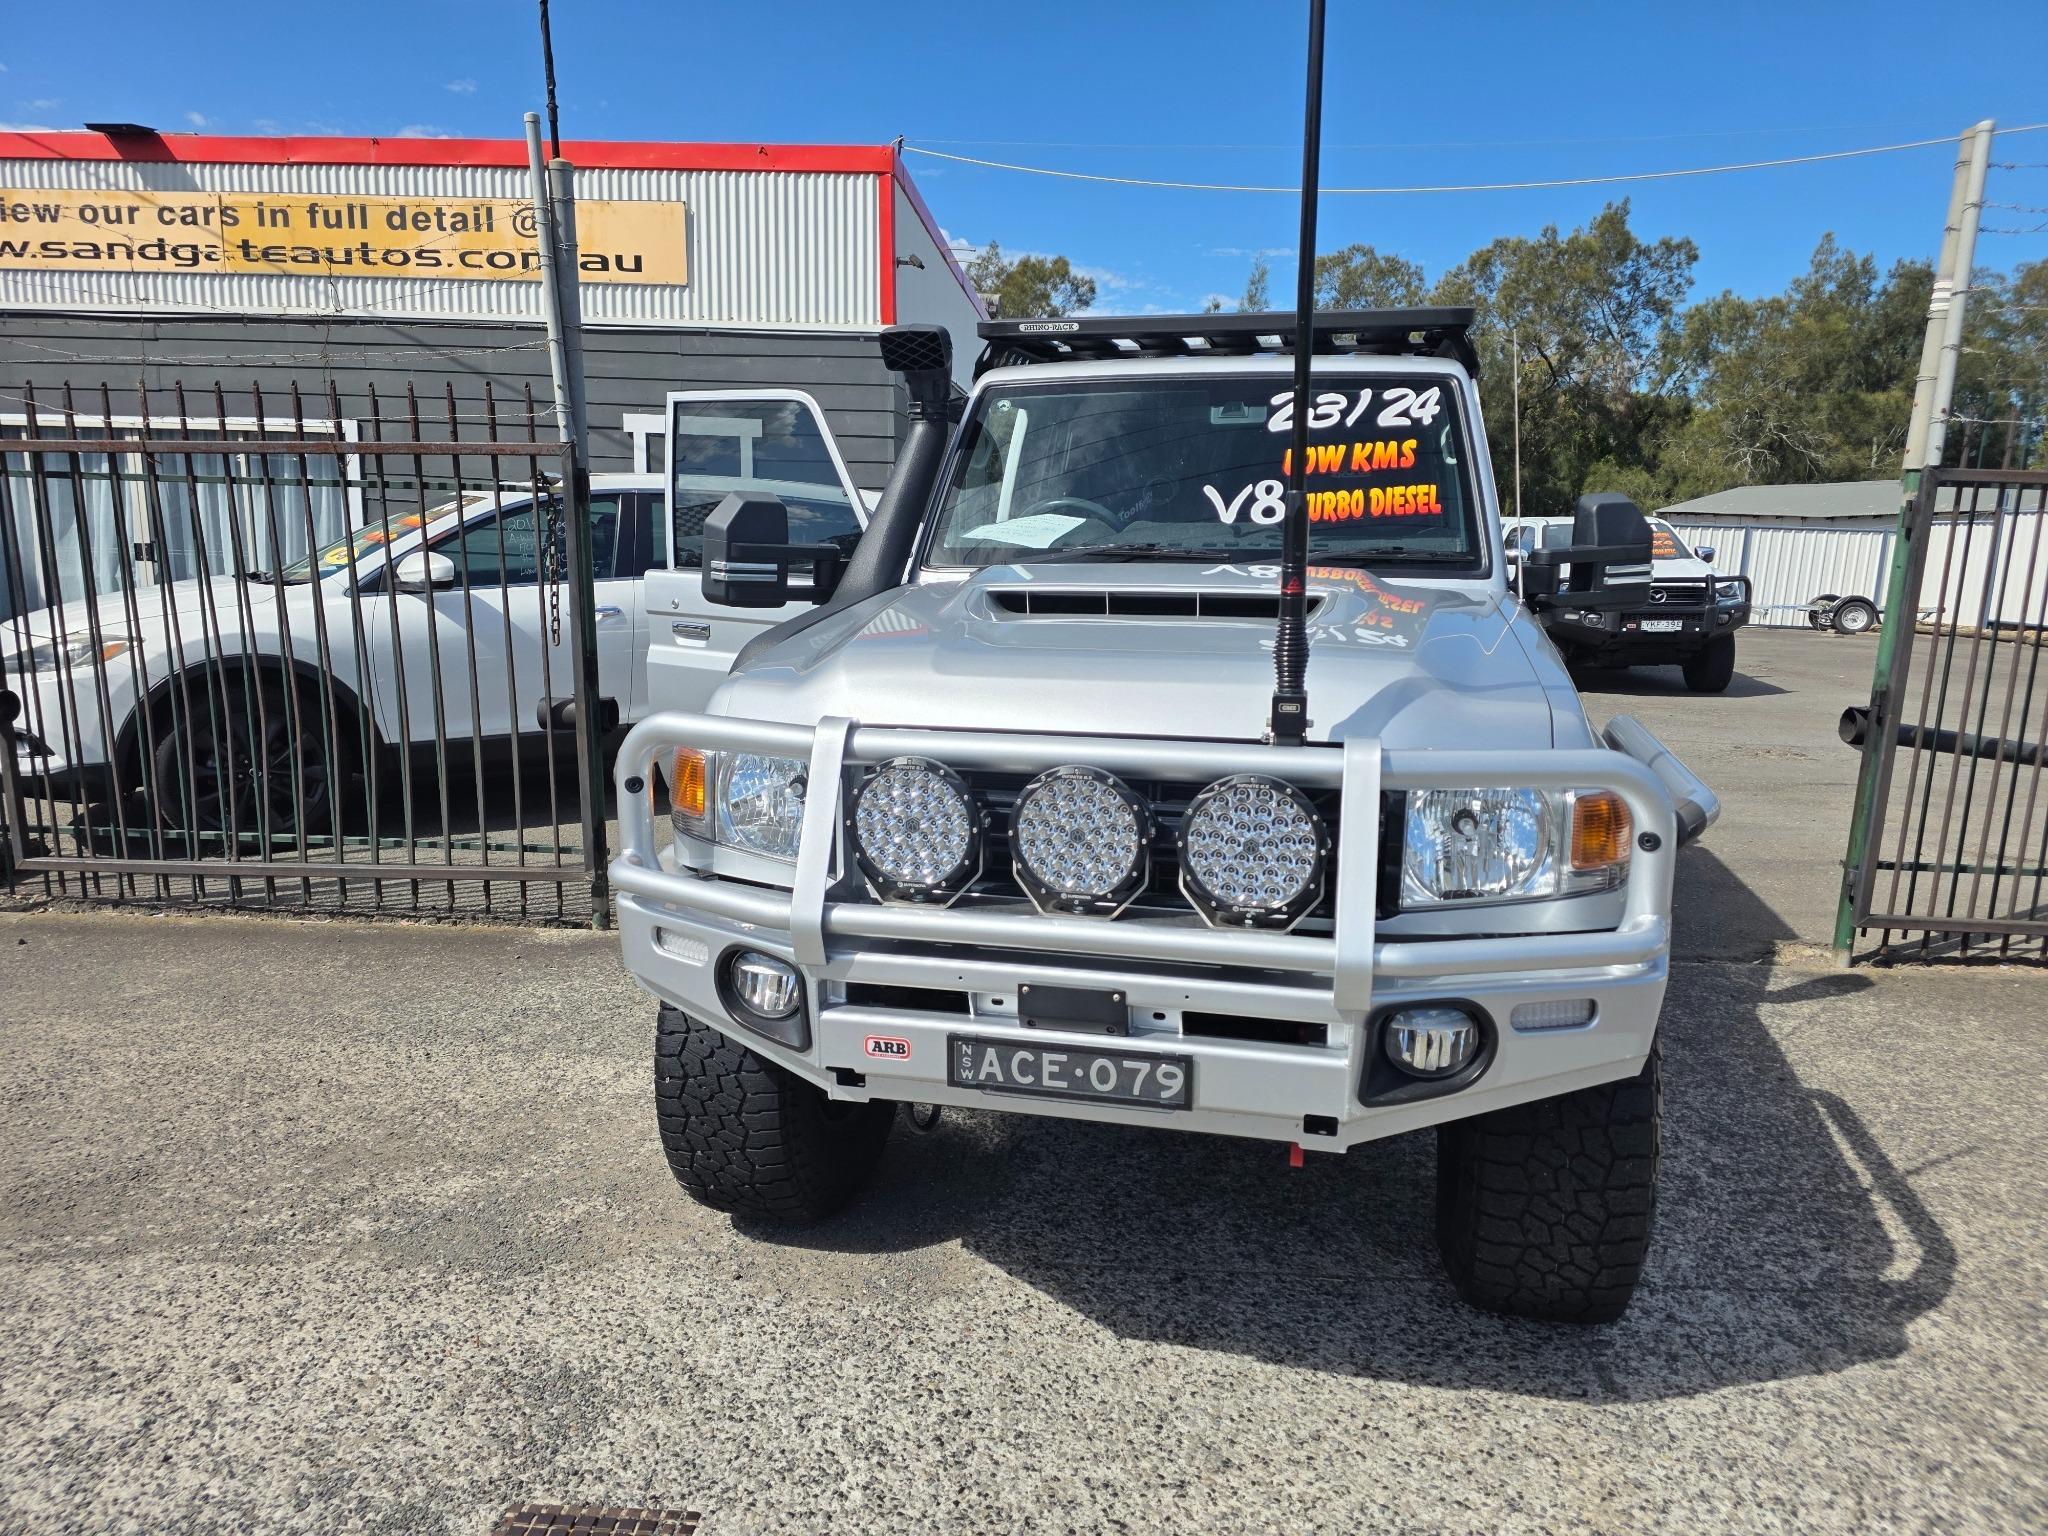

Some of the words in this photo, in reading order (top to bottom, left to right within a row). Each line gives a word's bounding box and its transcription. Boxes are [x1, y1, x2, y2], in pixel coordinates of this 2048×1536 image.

[78, 204, 140, 225] our
[157, 204, 240, 227] cars
[257, 201, 290, 228] in
[307, 202, 368, 230] full
[386, 204, 494, 233] detail
[1023, 323, 1075, 331] RHINO-RACK
[1351, 438, 1418, 472] KMS
[1203, 479, 1287, 525] V8
[1305, 488, 1364, 522] URBO
[1369, 484, 1442, 517] DIESEL
[872, 1040, 907, 1055] ARB
[961, 1043, 975, 1080] NSW
